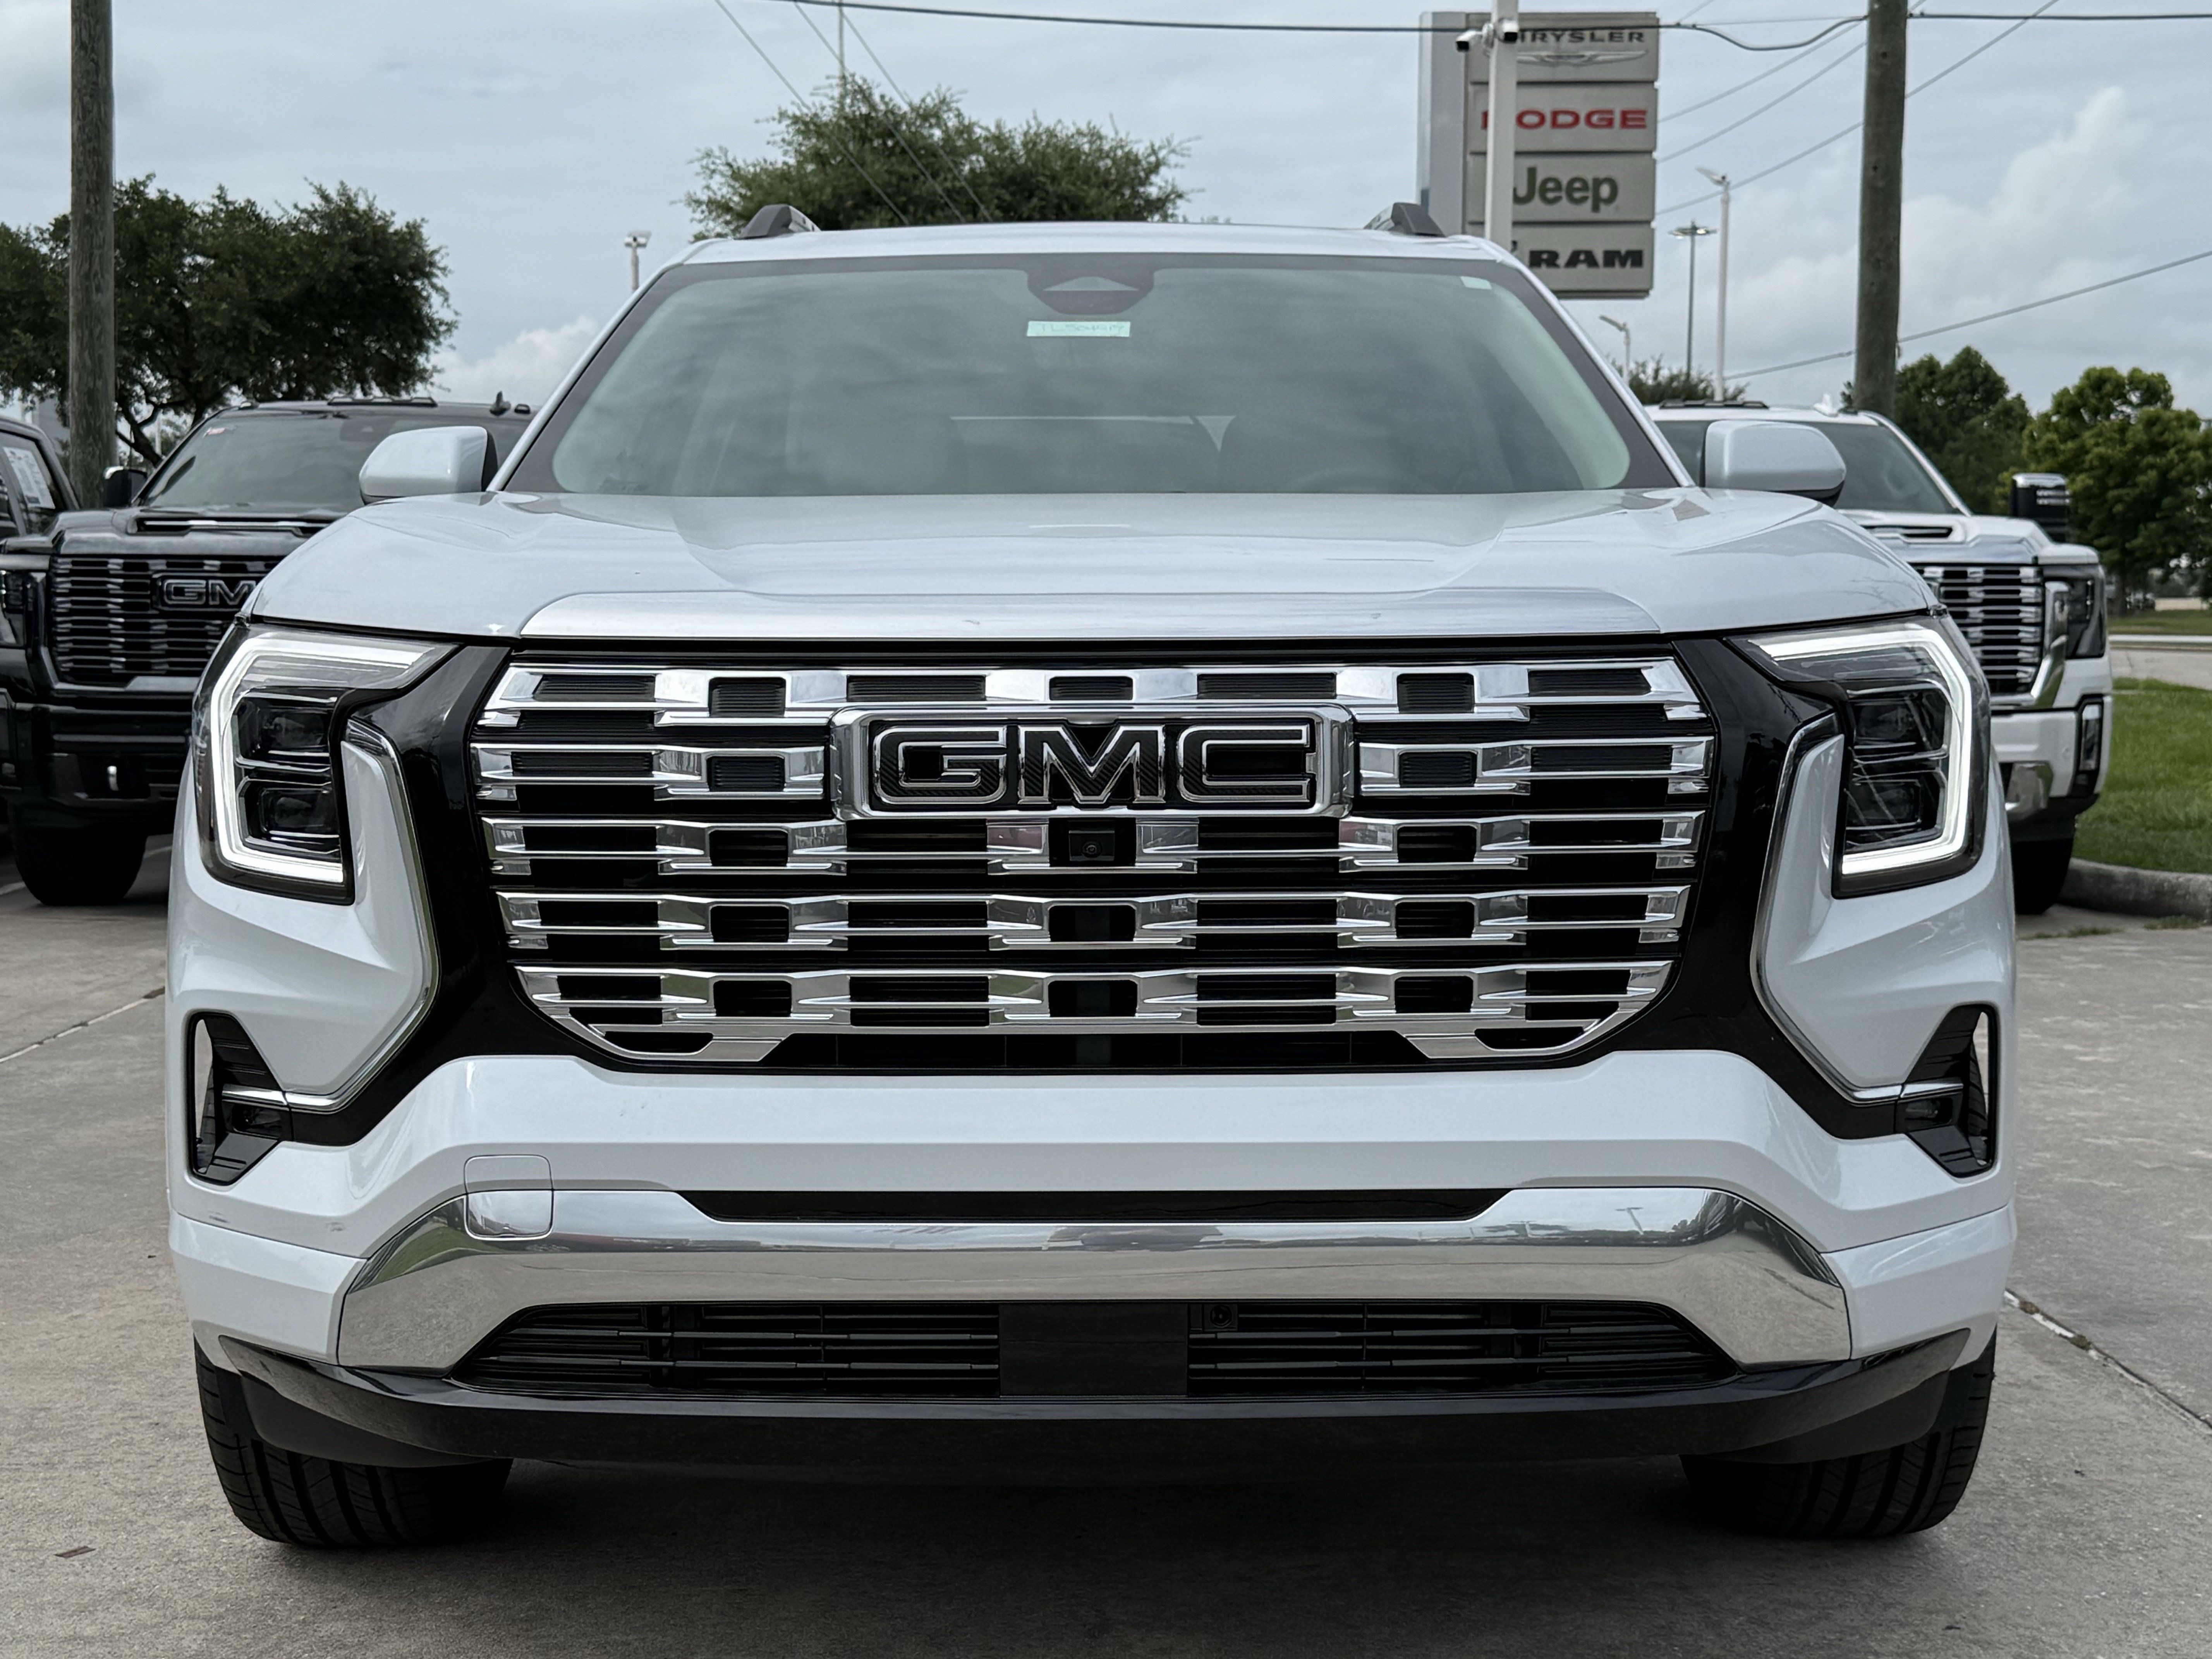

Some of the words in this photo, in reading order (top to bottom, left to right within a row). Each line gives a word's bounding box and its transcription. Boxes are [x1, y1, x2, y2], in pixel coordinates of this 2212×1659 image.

[1481, 109, 1647, 129] ODGE
[1513, 166, 1619, 213] Jeep
[1528, 250, 1644, 268] RAM
[164, 579, 256, 605] GM
[873, 725, 1310, 804] GMC
